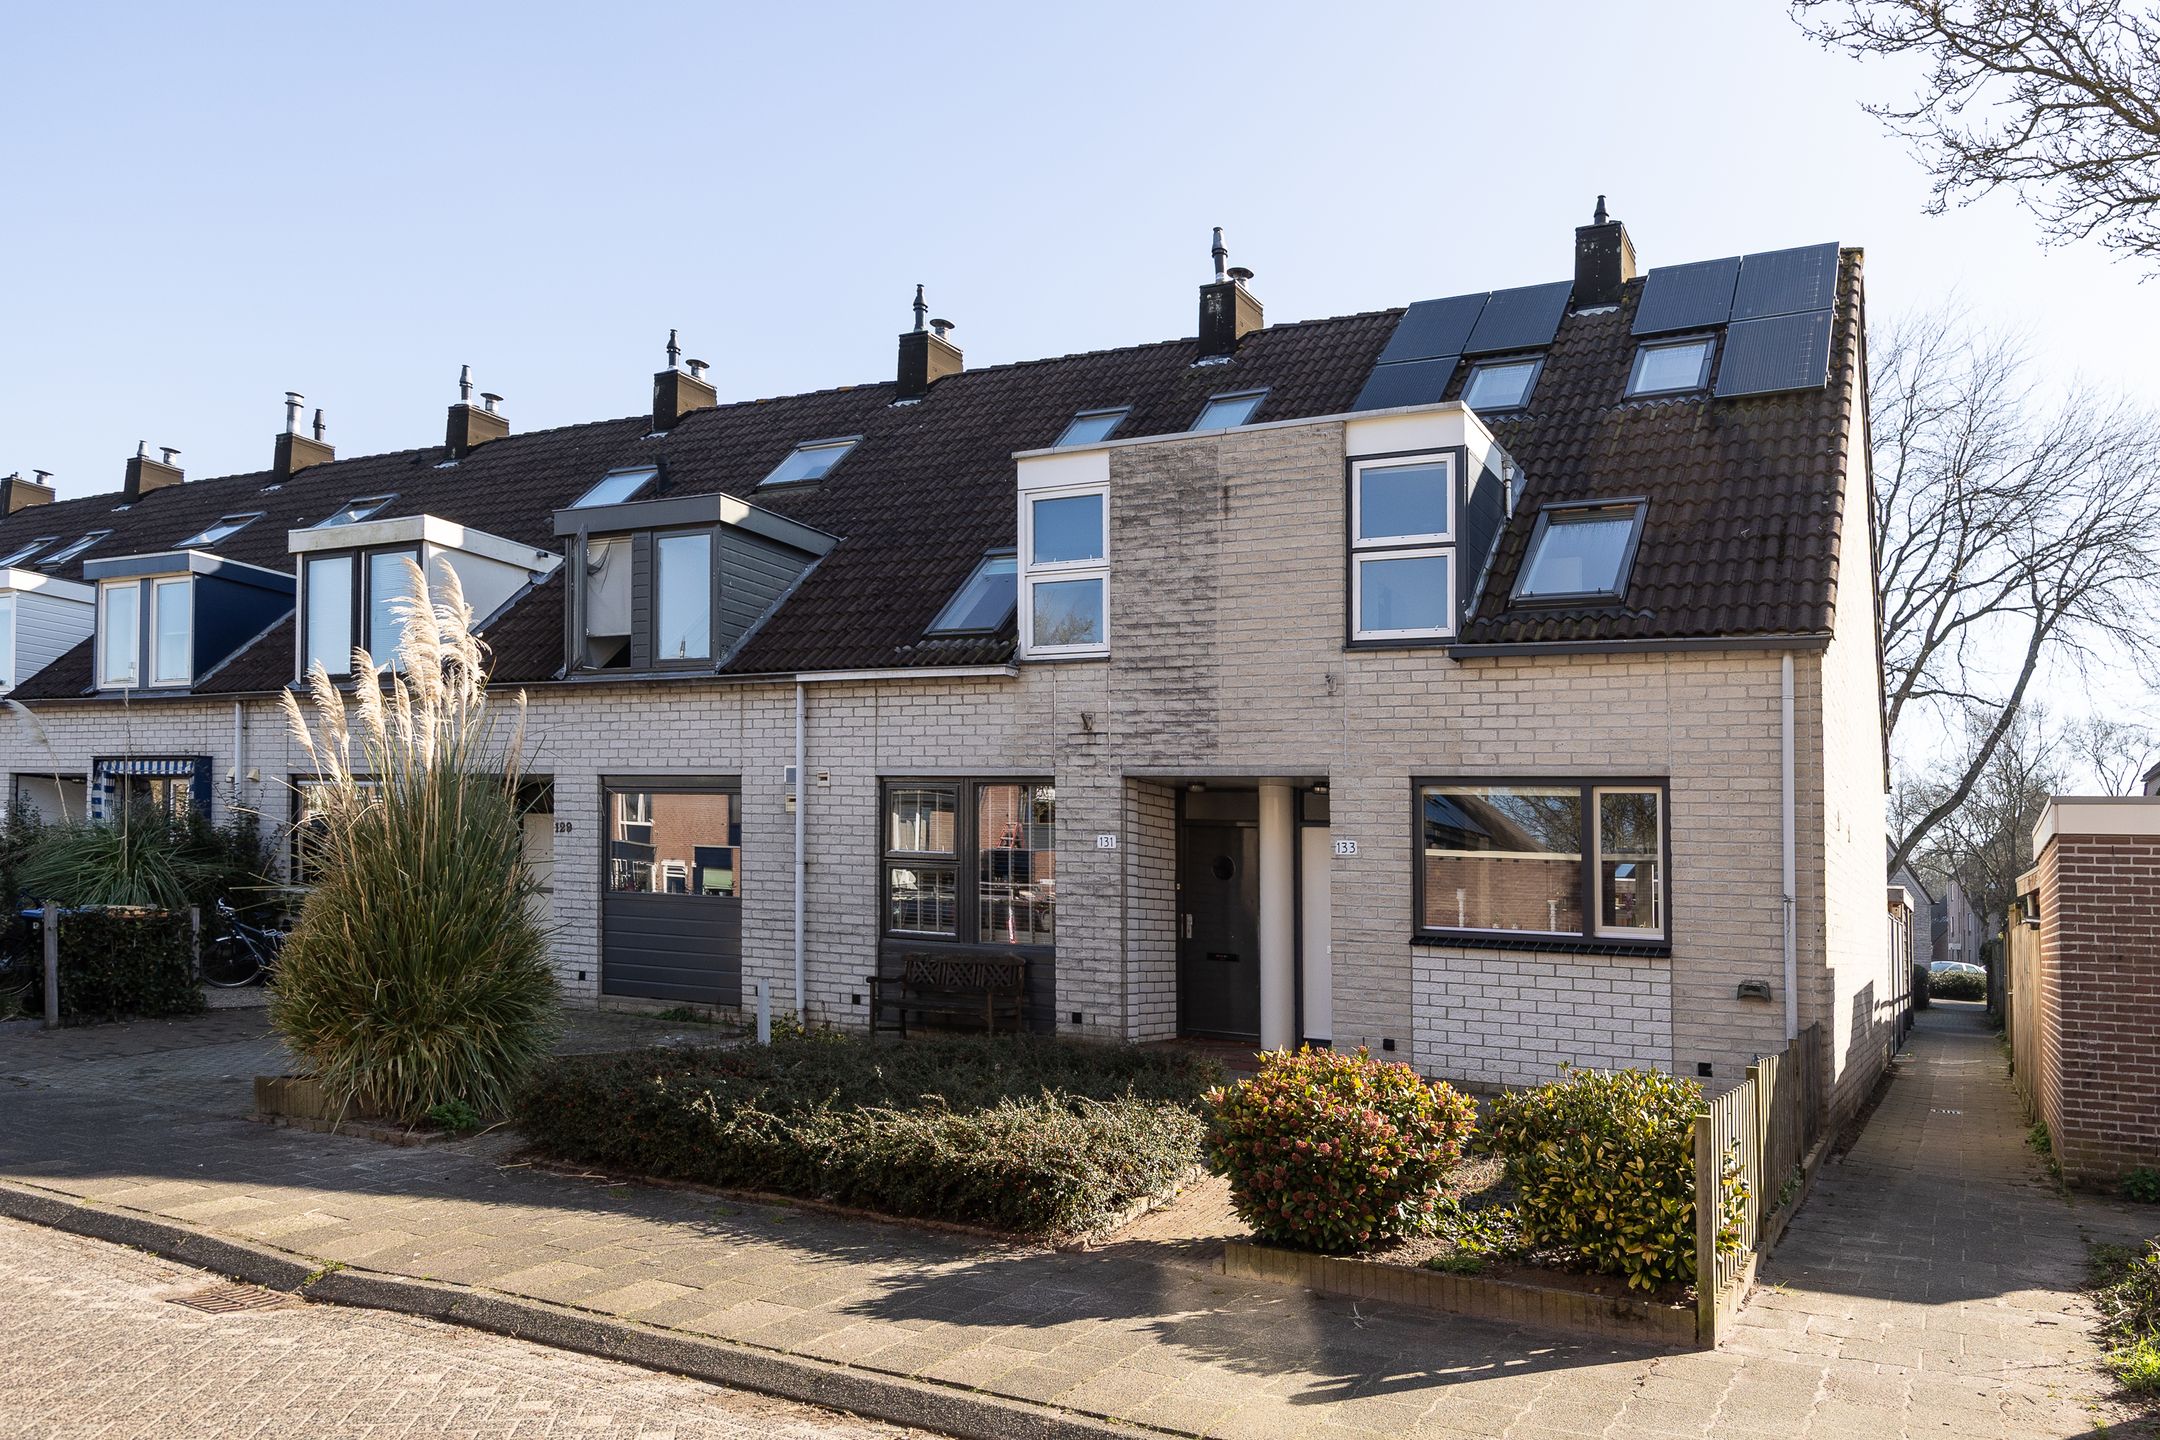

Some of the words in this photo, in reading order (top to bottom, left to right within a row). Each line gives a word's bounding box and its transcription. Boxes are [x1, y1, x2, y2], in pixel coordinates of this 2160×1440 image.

[555, 821, 572, 834] 129
[1099, 836, 1113, 848] 131
[1336, 842, 1356, 854] 133
